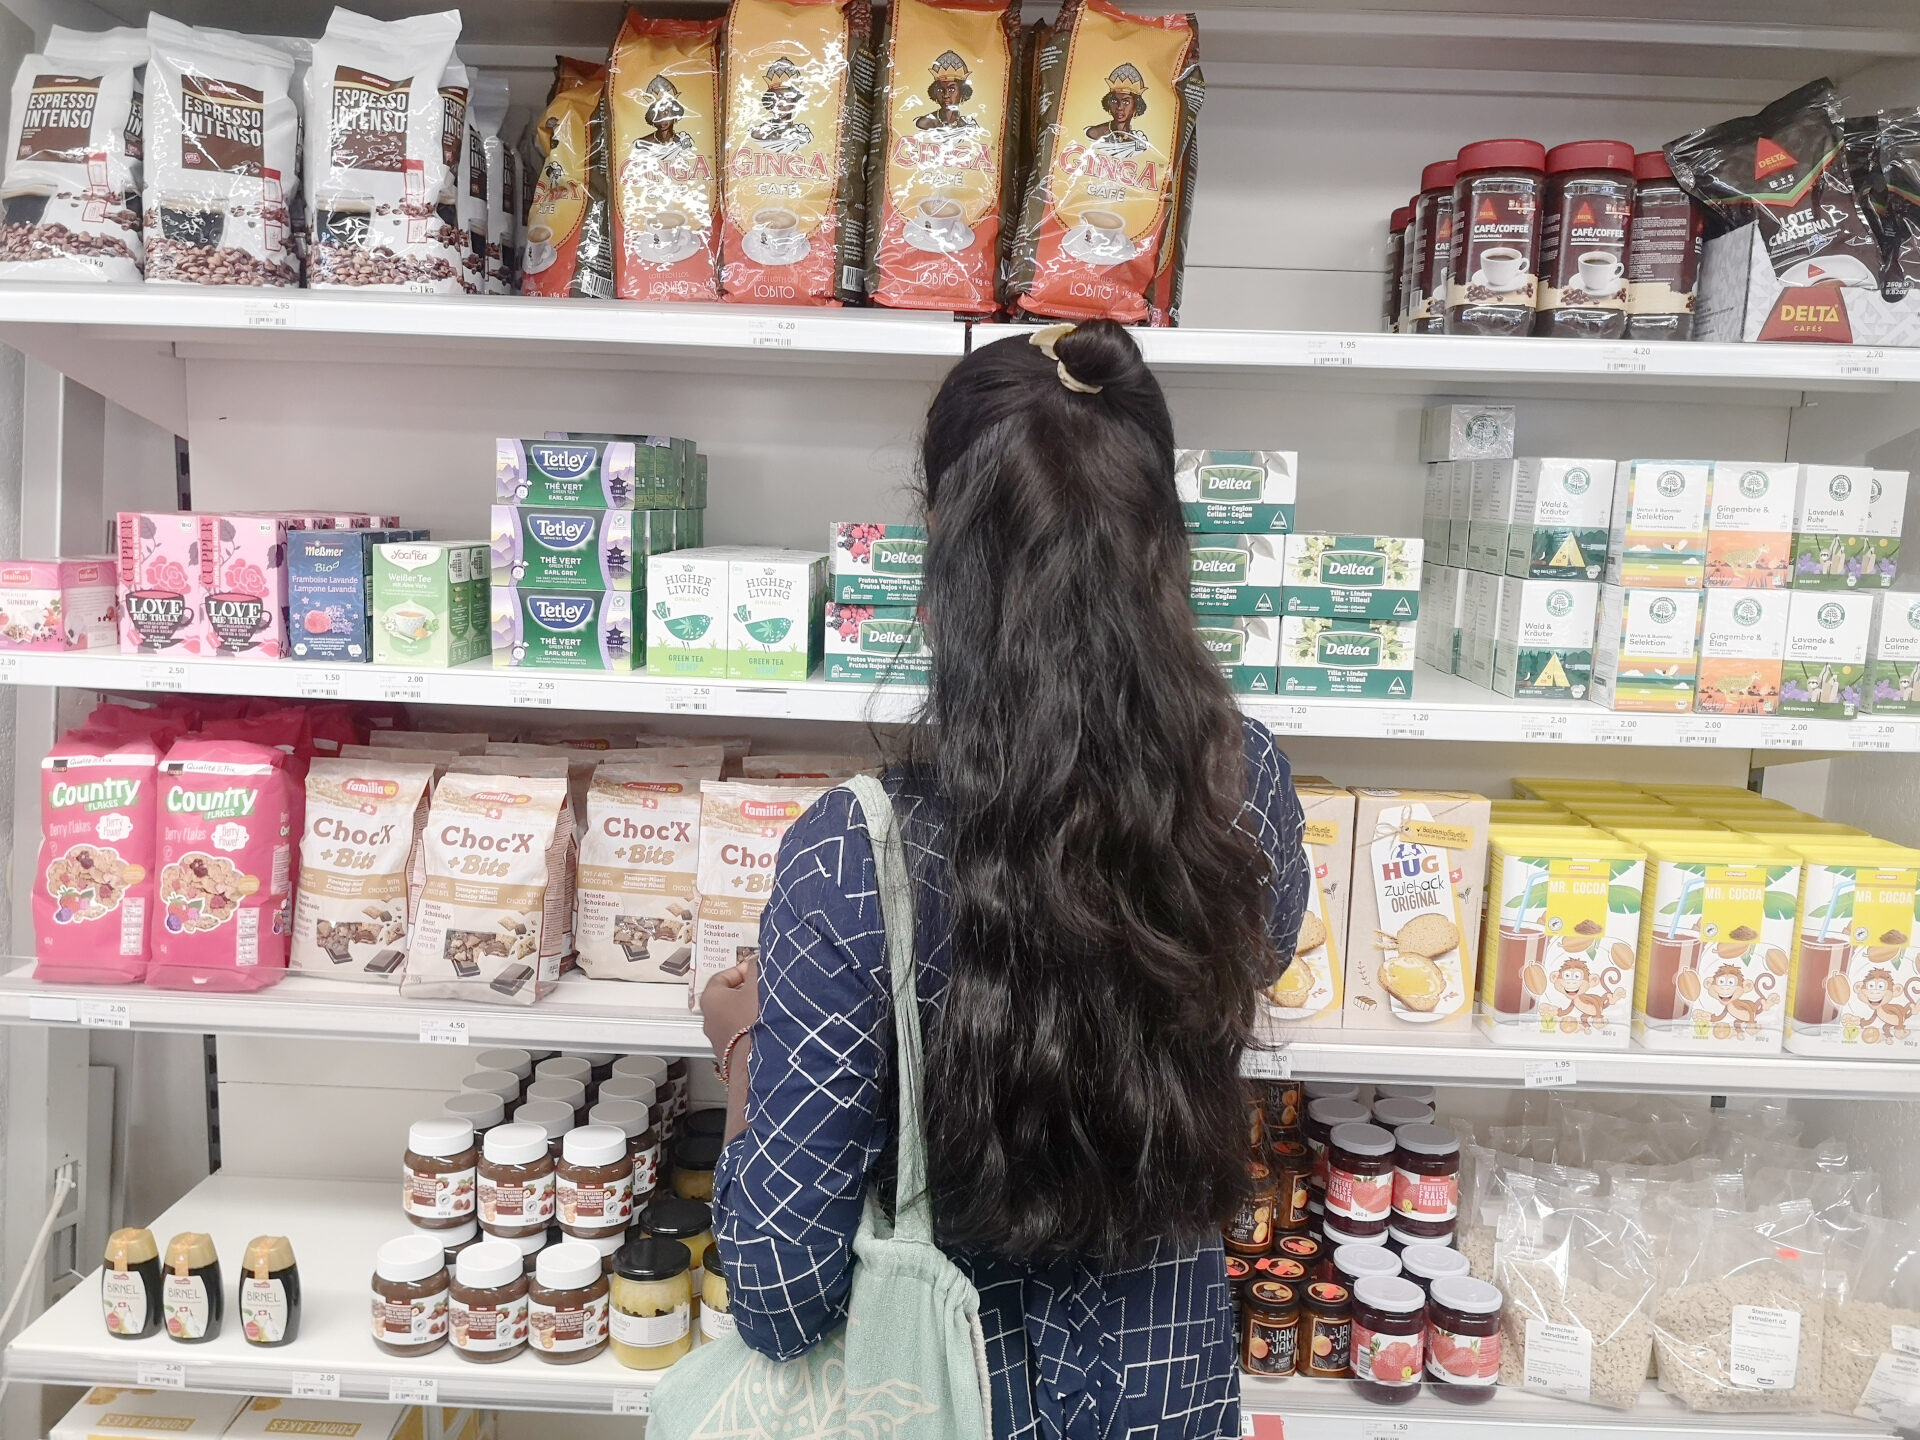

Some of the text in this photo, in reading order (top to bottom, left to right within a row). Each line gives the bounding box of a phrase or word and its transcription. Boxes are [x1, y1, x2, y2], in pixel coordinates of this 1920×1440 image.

[28, 93, 95, 109] ESPRESSO
[334, 89, 406, 110] ESPRESSO
[184, 95, 261, 127] ESPRESSO
[24, 109, 91, 128] INTENSO
[334, 107, 408, 133] INTENSO
[184, 112, 262, 147] INTENSO
[732, 148, 831, 180] GINGA
[1758, 153, 1787, 169] DELTA
[1059, 143, 1159, 193] GINGA
[1087, 183, 1127, 202] CAFÉ
[1780, 208, 1815, 229] LOTE
[1474, 224, 1530, 234] CAFÉ/COFFEE
[1571, 228, 1625, 238] CAFÉ/COFFEE
[915, 270, 959, 286] LOBITO
[753, 284, 795, 299] LOBITO
[1069, 282, 1113, 300] LOBITO
[273, 302, 290, 310] 4.95
[1780, 304, 1840, 322] DELTA
[778, 322, 795, 330] 6.20
[1794, 325, 1822, 333] CAFÉS
[1339, 341, 1357, 349] 1.95
[1633, 347, 1650, 355] 4.20
[540, 450, 589, 472] Tetley
[545, 481, 560, 490] THÉ
[1208, 476, 1252, 490] Deltea
[1541, 501, 1561, 509] Wald
[1717, 505, 1761, 514] Gingembre
[1540, 508, 1570, 516] Kräuter
[1636, 513, 1674, 521] Selektion
[536, 519, 586, 542] Tetley
[121, 520, 134, 582] CUPPER
[201, 523, 214, 585] CUPPER
[305, 546, 344, 557] Meßmer
[540, 556, 581, 565] THÉ VERT
[880, 551, 923, 564] Deltea
[1192, 559, 1236, 573] Deltea
[1328, 562, 1375, 577] Deltea
[292, 575, 359, 584] Framboise Lavande
[388, 572, 432, 583] Weißer Tee
[664, 574, 712, 587] HIGHER
[746, 577, 793, 590] HIGHER
[294, 585, 356, 594] Lampone Lavanda
[667, 585, 709, 597] LIVING
[748, 588, 790, 600] LIVING
[129, 597, 183, 616] LOVE
[208, 601, 261, 618] LOVE
[536, 601, 586, 623] Tetley
[133, 613, 180, 622] ME TRULY
[212, 616, 257, 625] ME TRULY
[1525, 623, 1546, 631] Wald
[1524, 629, 1553, 637] Kräuter
[1709, 632, 1755, 642] Gingembre
[540, 636, 581, 646] THÉ VERT
[1629, 638, 1666, 647] Selektion
[1792, 636, 1826, 644] Lavande
[1326, 643, 1370, 656] Deltea
[1791, 643, 1817, 651] Calme
[1884, 643, 1909, 651] Calme
[668, 654, 704, 663] GREEN TEA
[749, 658, 770, 666] GREEN
[538, 682, 555, 690] 2.95
[1290, 706, 1307, 714] 1.20
[1550, 716, 1567, 724] 2.40
[1620, 720, 1637, 728] 2.00
[52, 778, 141, 806] Country
[347, 781, 383, 794] familia
[626, 783, 667, 793] familia
[167, 786, 258, 815] Country
[474, 792, 515, 803] familia
[88, 800, 119, 811] FLAKES
[744, 804, 785, 817] familia
[208, 808, 235, 818] FLAKES
[603, 817, 690, 843] Choc'X
[440, 825, 535, 854] Choc'X
[1381, 855, 1440, 881] HUG
[1550, 881, 1607, 894] MR. COCOA
[1705, 888, 1762, 900] MR. COCOA
[1856, 891, 1913, 904] MR. COCOA
[584, 899, 620, 908] Schokolade
[1391, 890, 1440, 913] ORIGINAL
[583, 914, 609, 922] chocolate
[704, 922, 724, 930] feinste
[704, 930, 740, 939] Schokolade
[703, 946, 730, 954] chocolate
[1419, 1191, 1448, 1200] FRAISE
[107, 1283, 139, 1295] BIRNEL
[168, 1286, 201, 1300] BIRNEL
[246, 1291, 279, 1303] BIRNEL
[1751, 1308, 1783, 1318] Sternchen
[1748, 1315, 1778, 1325] extrudiert
[1545, 1324, 1575, 1334] Sternchen
[1540, 1331, 1570, 1341] extrudiert
[166, 1364, 182, 1372] 2.40
[1734, 1364, 1755, 1375] 250g
[1527, 1375, 1548, 1386] 250g
[102, 1414, 189, 1431] CORNFLAKES
[270, 1420, 356, 1436] CORNFLAKES
[1393, 1423, 1408, 1431] 1.50
